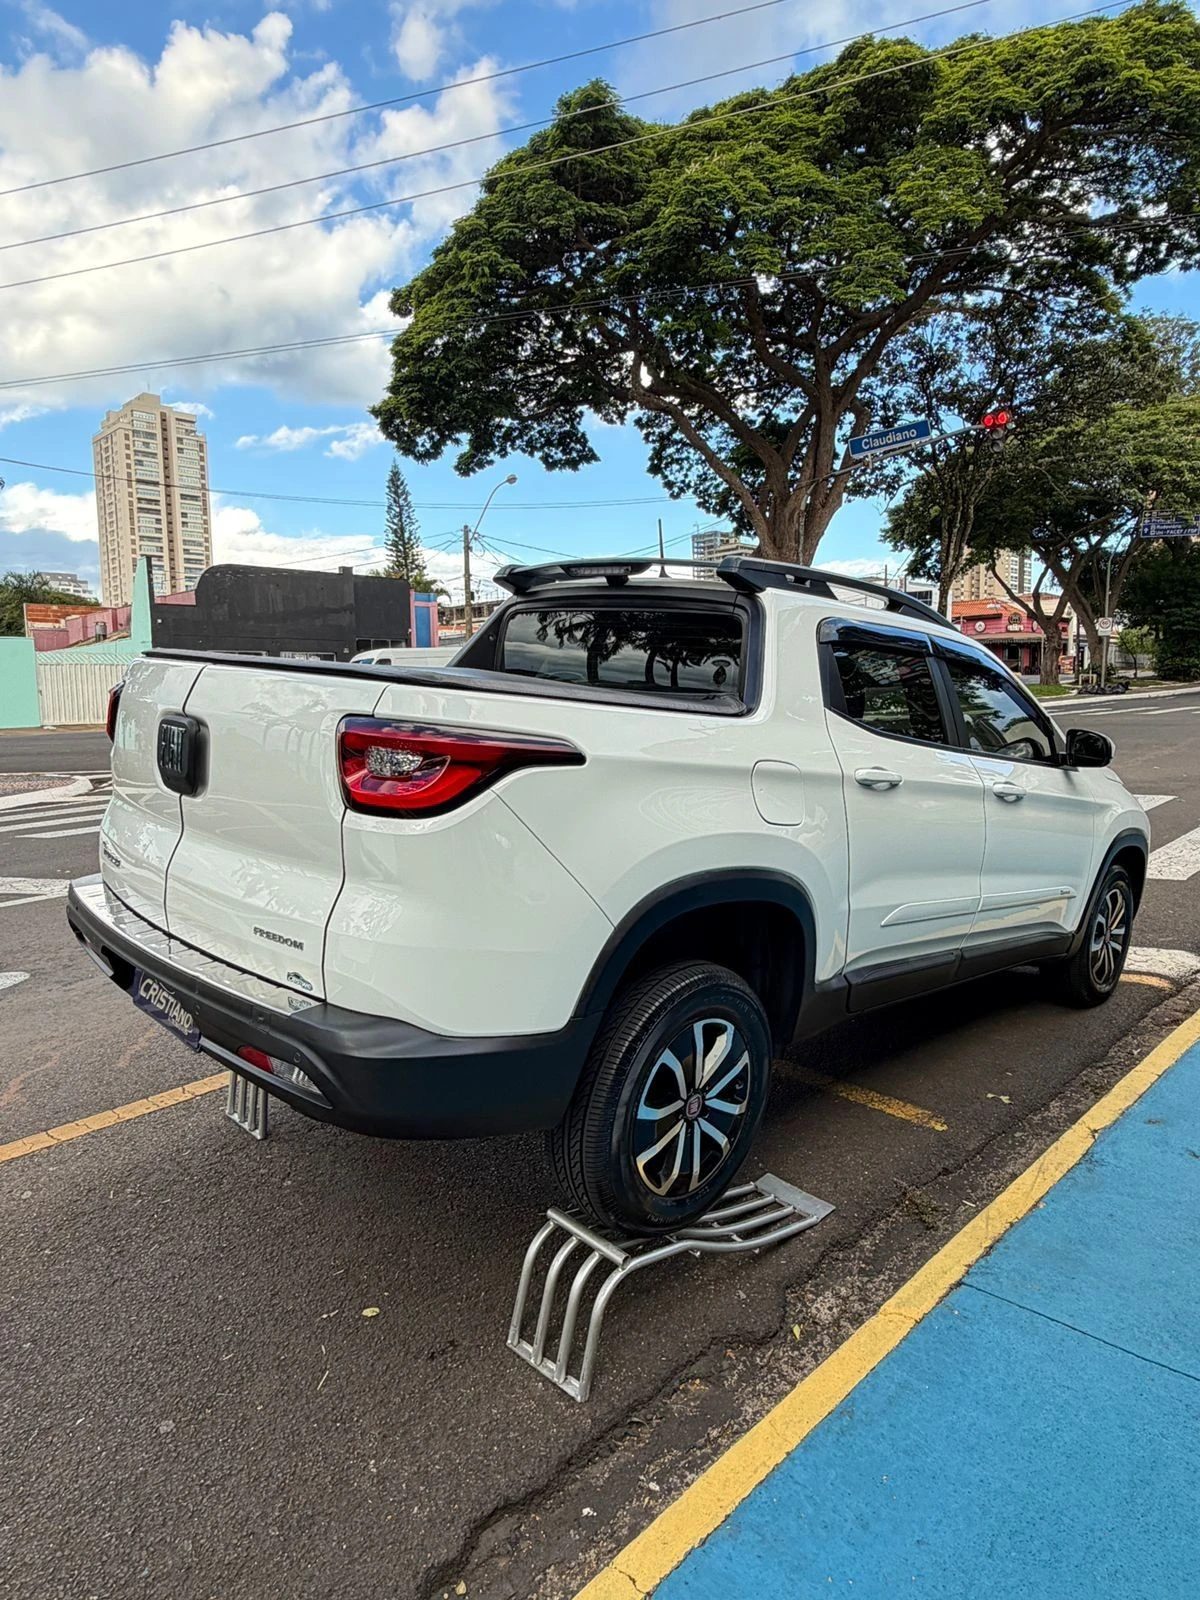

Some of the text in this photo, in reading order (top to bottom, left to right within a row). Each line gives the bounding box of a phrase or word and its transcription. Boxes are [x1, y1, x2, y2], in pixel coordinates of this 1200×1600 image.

[861, 428, 917, 450] Claudiano
[253, 926, 304, 951] FREEDOM
[139, 978, 194, 1028] CRISTIANO
